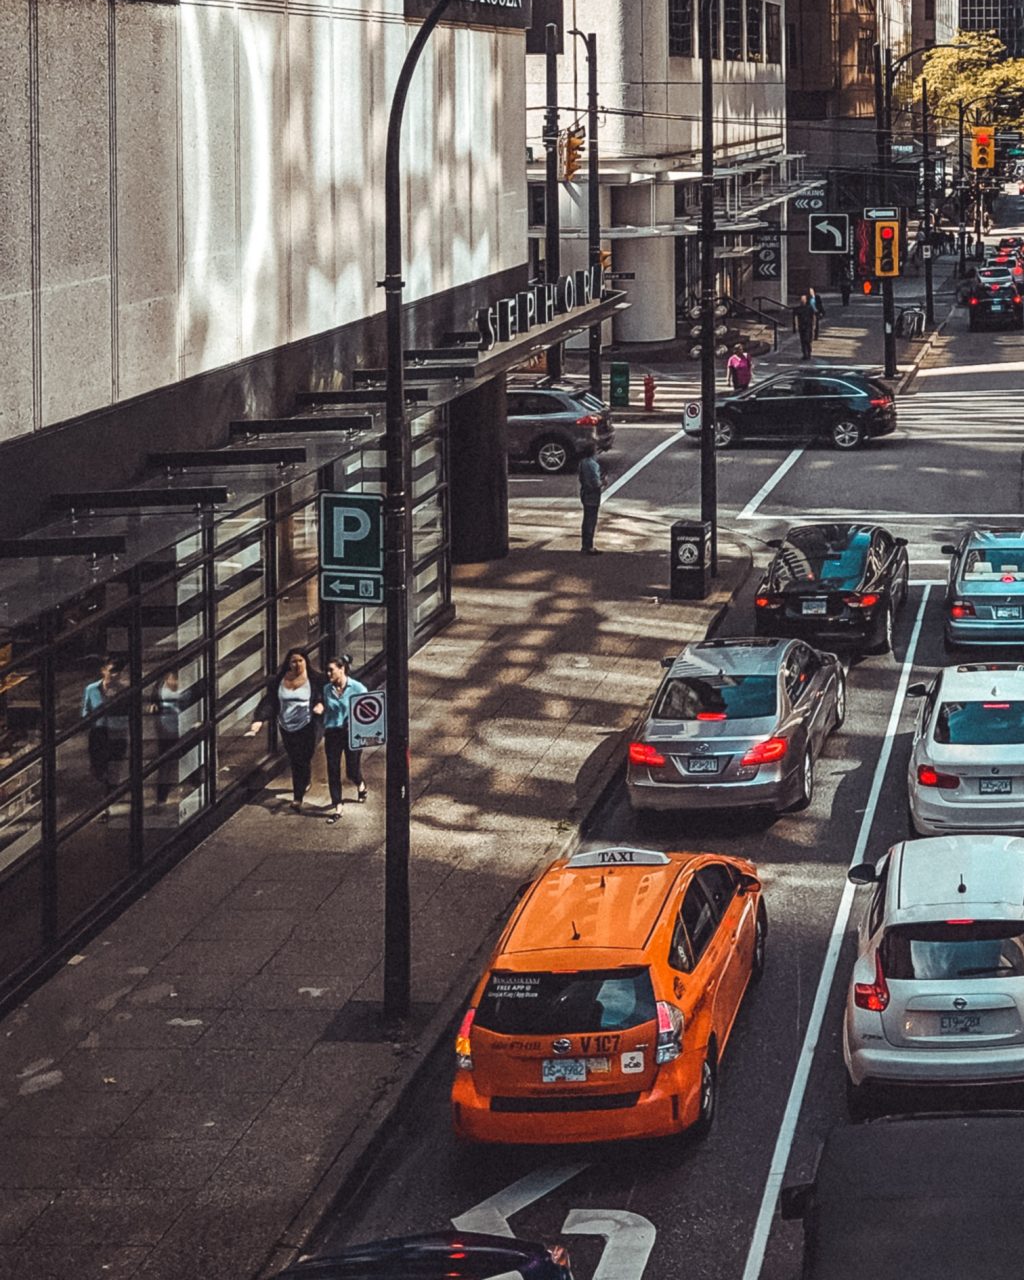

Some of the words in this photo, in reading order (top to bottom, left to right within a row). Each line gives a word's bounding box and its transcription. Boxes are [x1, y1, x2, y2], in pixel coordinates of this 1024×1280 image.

[478, 266, 606, 351] SEPHORA
[333, 506, 371, 558] P
[598, 852, 635, 862] TAXI
